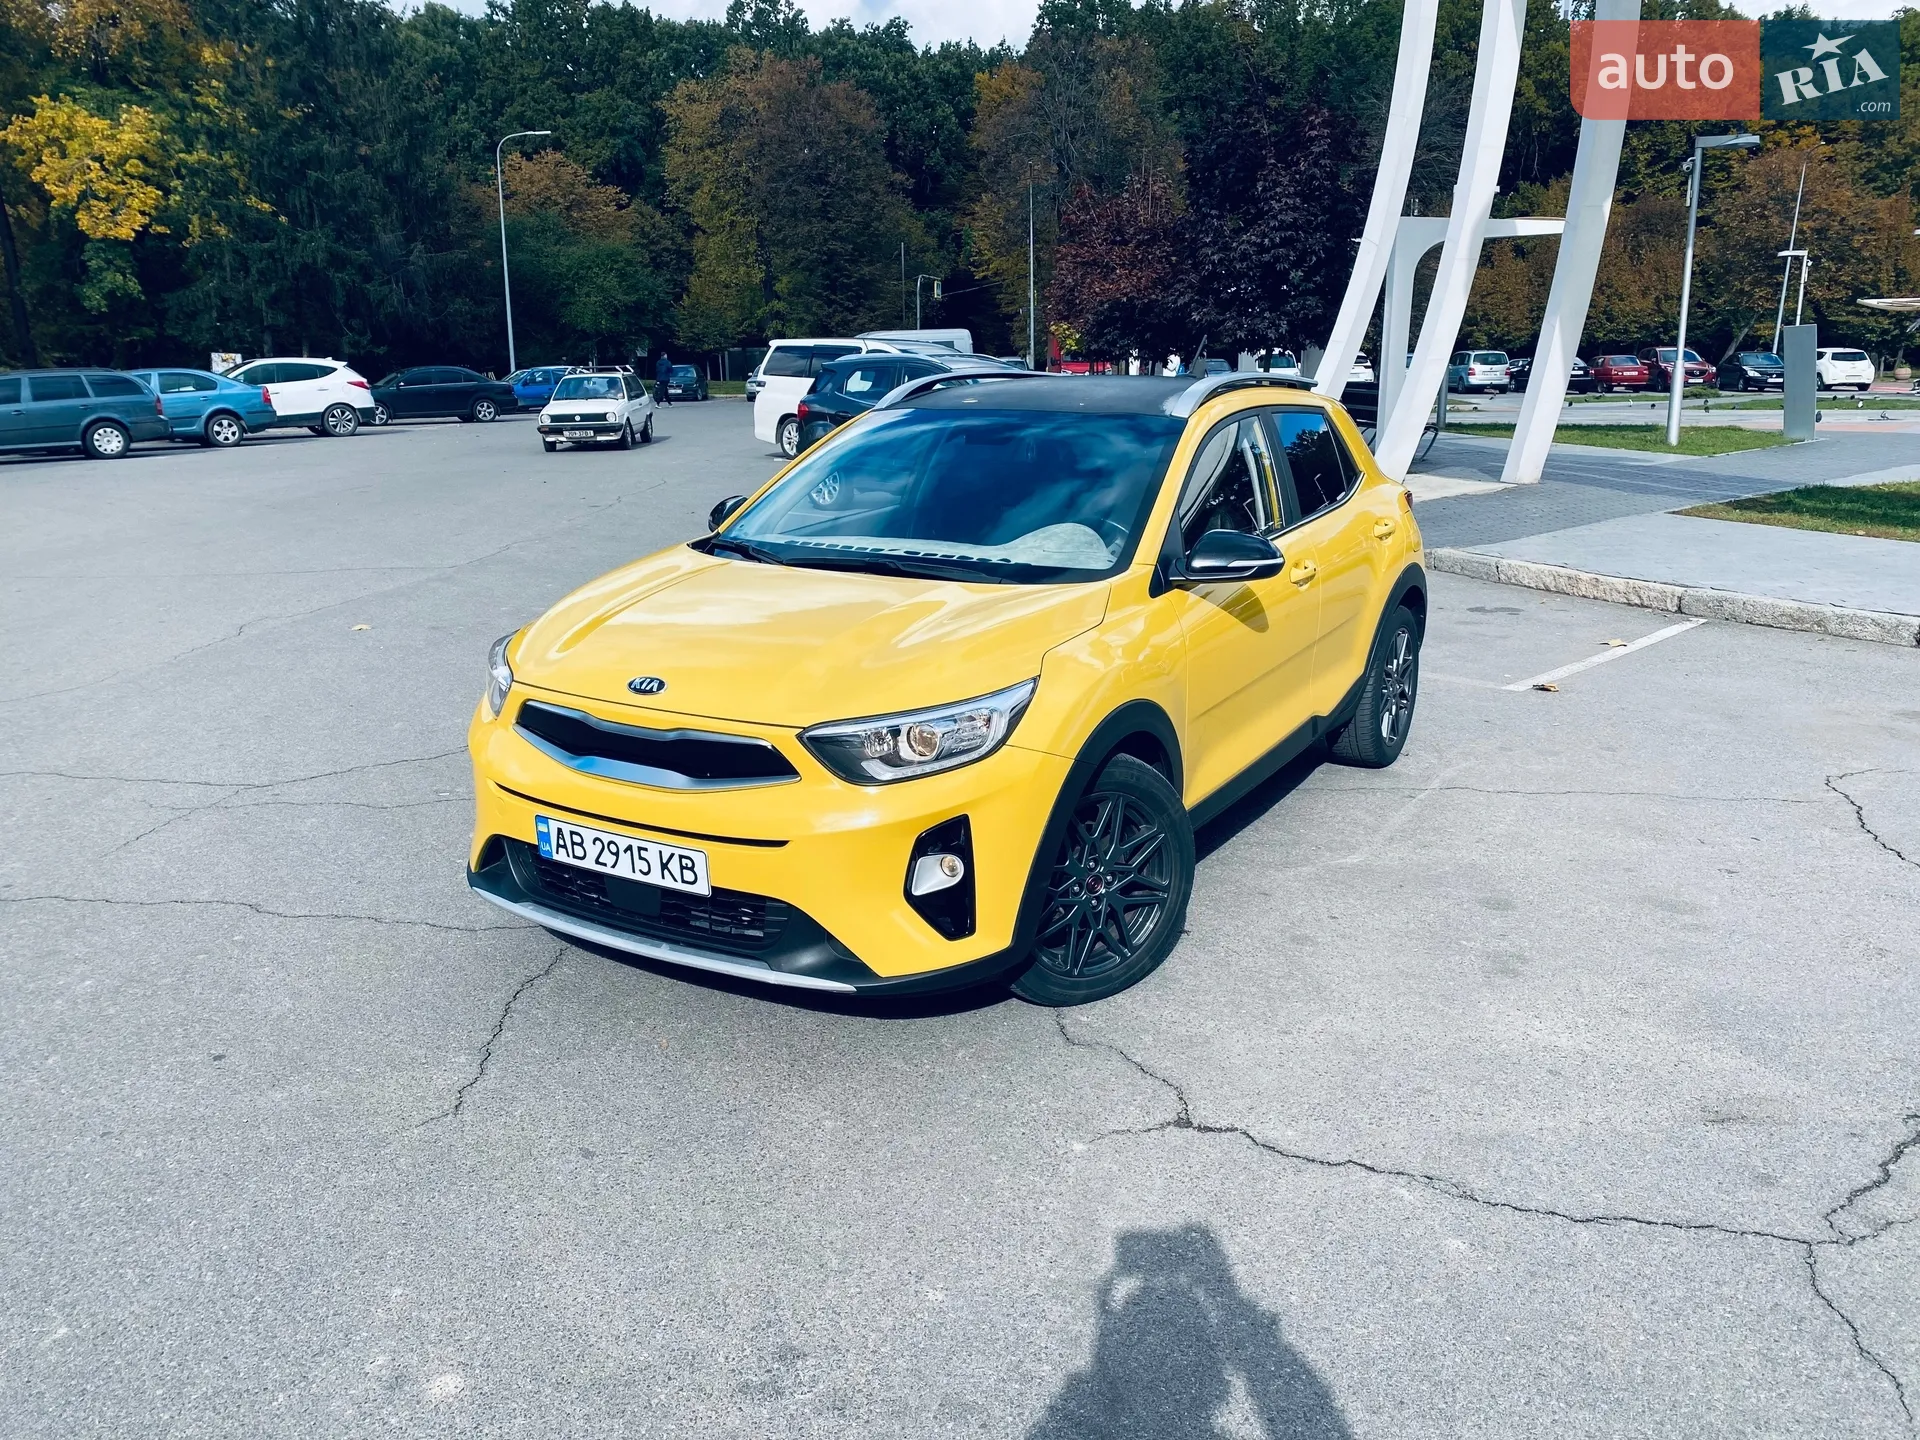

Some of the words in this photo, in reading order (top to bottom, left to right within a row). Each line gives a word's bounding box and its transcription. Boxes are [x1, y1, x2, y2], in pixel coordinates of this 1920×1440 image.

[630, 677, 660, 692] KIA
[540, 841, 552, 853] UA
[555, 827, 587, 861] AB
[592, 836, 652, 877] 2915
[658, 850, 699, 886] KB
